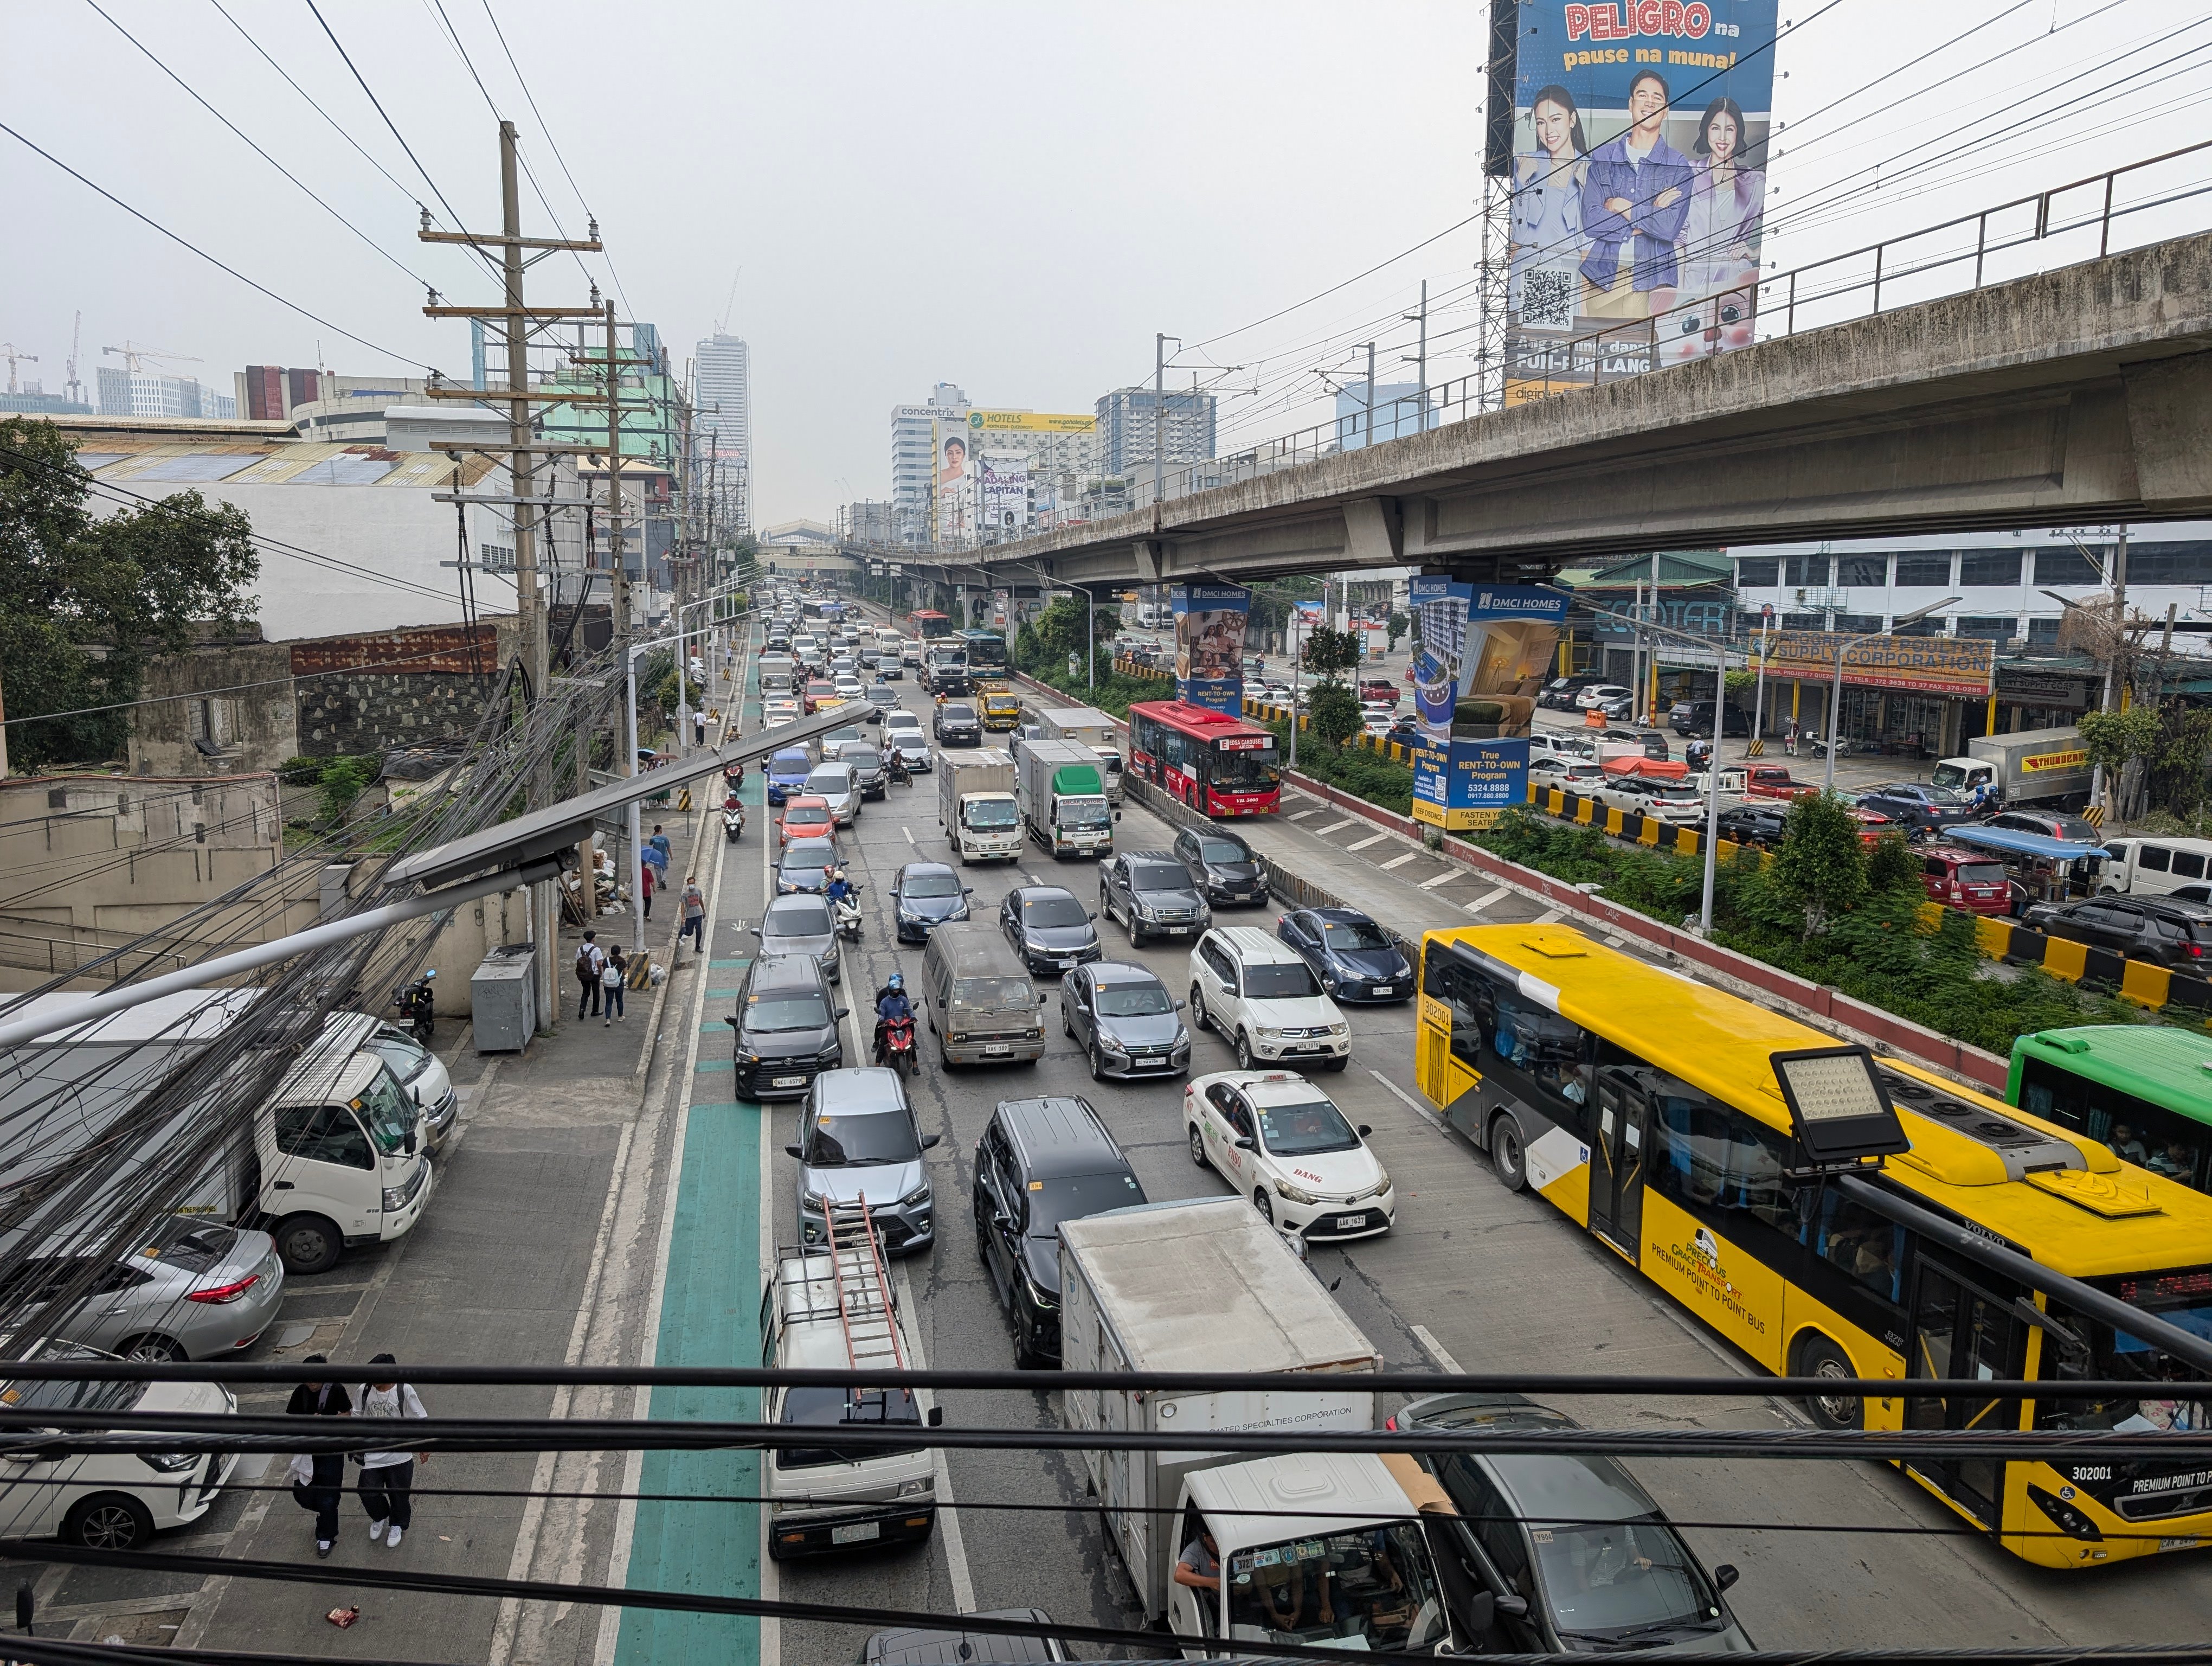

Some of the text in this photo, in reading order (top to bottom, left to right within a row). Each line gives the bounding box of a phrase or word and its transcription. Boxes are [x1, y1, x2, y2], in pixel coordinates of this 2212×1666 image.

[1715, 22, 1740, 37] na
[1564, 48, 1736, 71] pause na muna!
[1610, 341, 1651, 356] dapat
[1603, 358, 1650, 373] LANG
[902, 407, 955, 416] concentrix
[987, 414, 1022, 423] HOTELS
[1419, 584, 1446, 593] DMCI HOMES
[1492, 598, 1561, 609] DMCI HOMES
[1847, 650, 1987, 671] CORPORATION
[1427, 739, 1437, 749] True
[1416, 748, 1447, 763] RENT-TO-OWN
[2039, 752, 2084, 766] THUNDERB
[1422, 760, 1440, 773] Program
[1471, 772, 1507, 781] Program
[1415, 806, 1443, 821] KEEP DISTANCE
[1425, 1001, 1449, 1026] 302001
[1228, 1145, 1242, 1168] PNSO
[1293, 1169, 1323, 1183] DANG
[1339, 1218, 1349, 1227] AAK
[1964, 1220, 2005, 1247] VOLVO
[1671, 1244, 1696, 1268] GRACE
[1652, 1242, 1765, 1334] PREMIUM POINT TO POINT BUS
[1887, 1330, 1904, 1345] B7R
[1242, 1417, 1293, 1431] SPECIALTIES
[1295, 1407, 1352, 1423] CORPORATION
[2072, 1466, 2112, 1480] 302001
[2133, 1471, 2207, 1492] PREMIUM POINT TO
[1238, 1558, 1253, 1569] 3727
